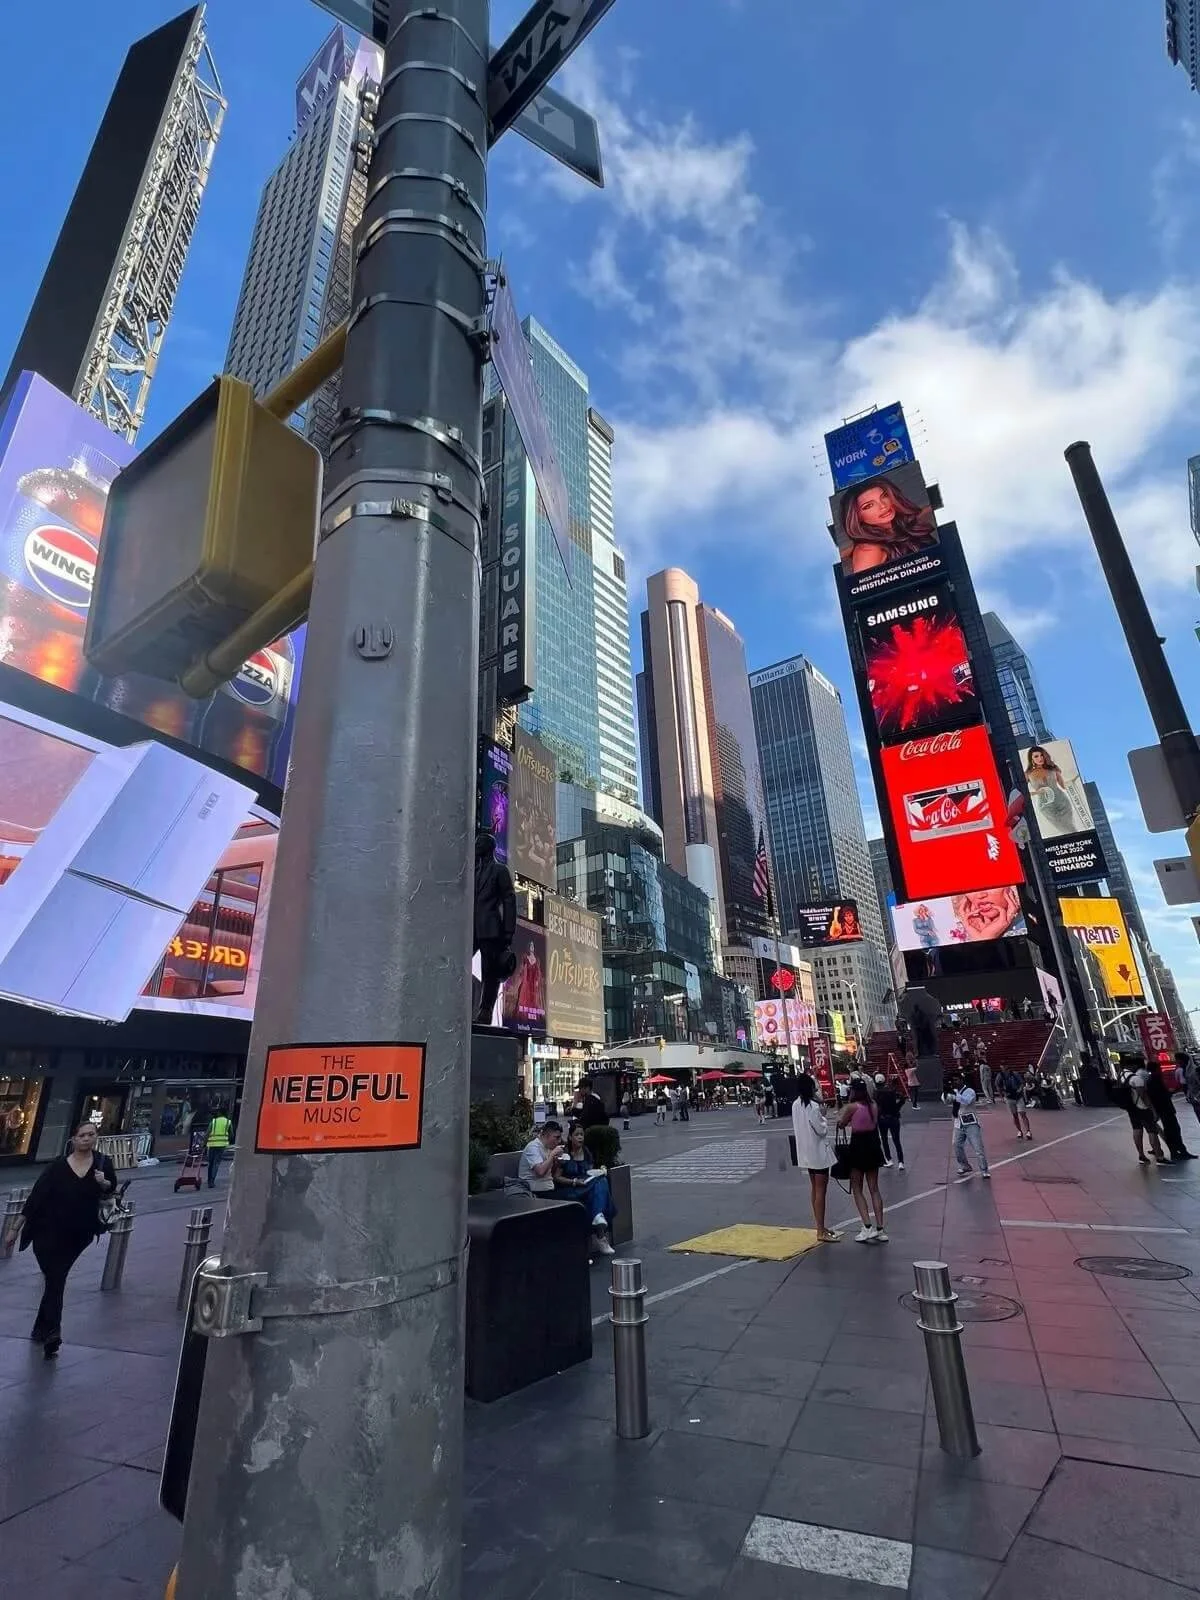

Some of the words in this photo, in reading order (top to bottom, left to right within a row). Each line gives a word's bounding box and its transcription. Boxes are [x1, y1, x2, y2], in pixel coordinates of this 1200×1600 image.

[132, 203, 179, 335] AMERICAN
[835, 448, 868, 469] WORK
[32, 540, 93, 586] WING
[851, 573, 900, 595] CHRISTIANA
[900, 559, 941, 578] DINARDO
[872, 570, 887, 580] NEW
[887, 565, 902, 575] YORK
[501, 523, 520, 674] SQUARE
[867, 595, 939, 627] SAMSUNG
[756, 669, 787, 684] Allianz
[1045, 845, 1060, 854] MISS
[1060, 842, 1075, 851] NEW
[1076, 839, 1093, 848] YORK
[1049, 853, 1097, 868] CHRISTIANA
[1055, 860, 1094, 873] DINARDO
[548, 912, 567, 937] BEST
[569, 920, 599, 949] MUSICAL
[550, 950, 599, 993] OUTSIDERS
[1145, 1015, 1169, 1051] tkts
[320, 1055, 356, 1070] THE
[588, 1059, 620, 1071] KLIKTIX
[813, 1038, 826, 1071] tkts
[271, 1073, 410, 1104] NEEDFUL
[303, 1106, 362, 1124] MUSIC
